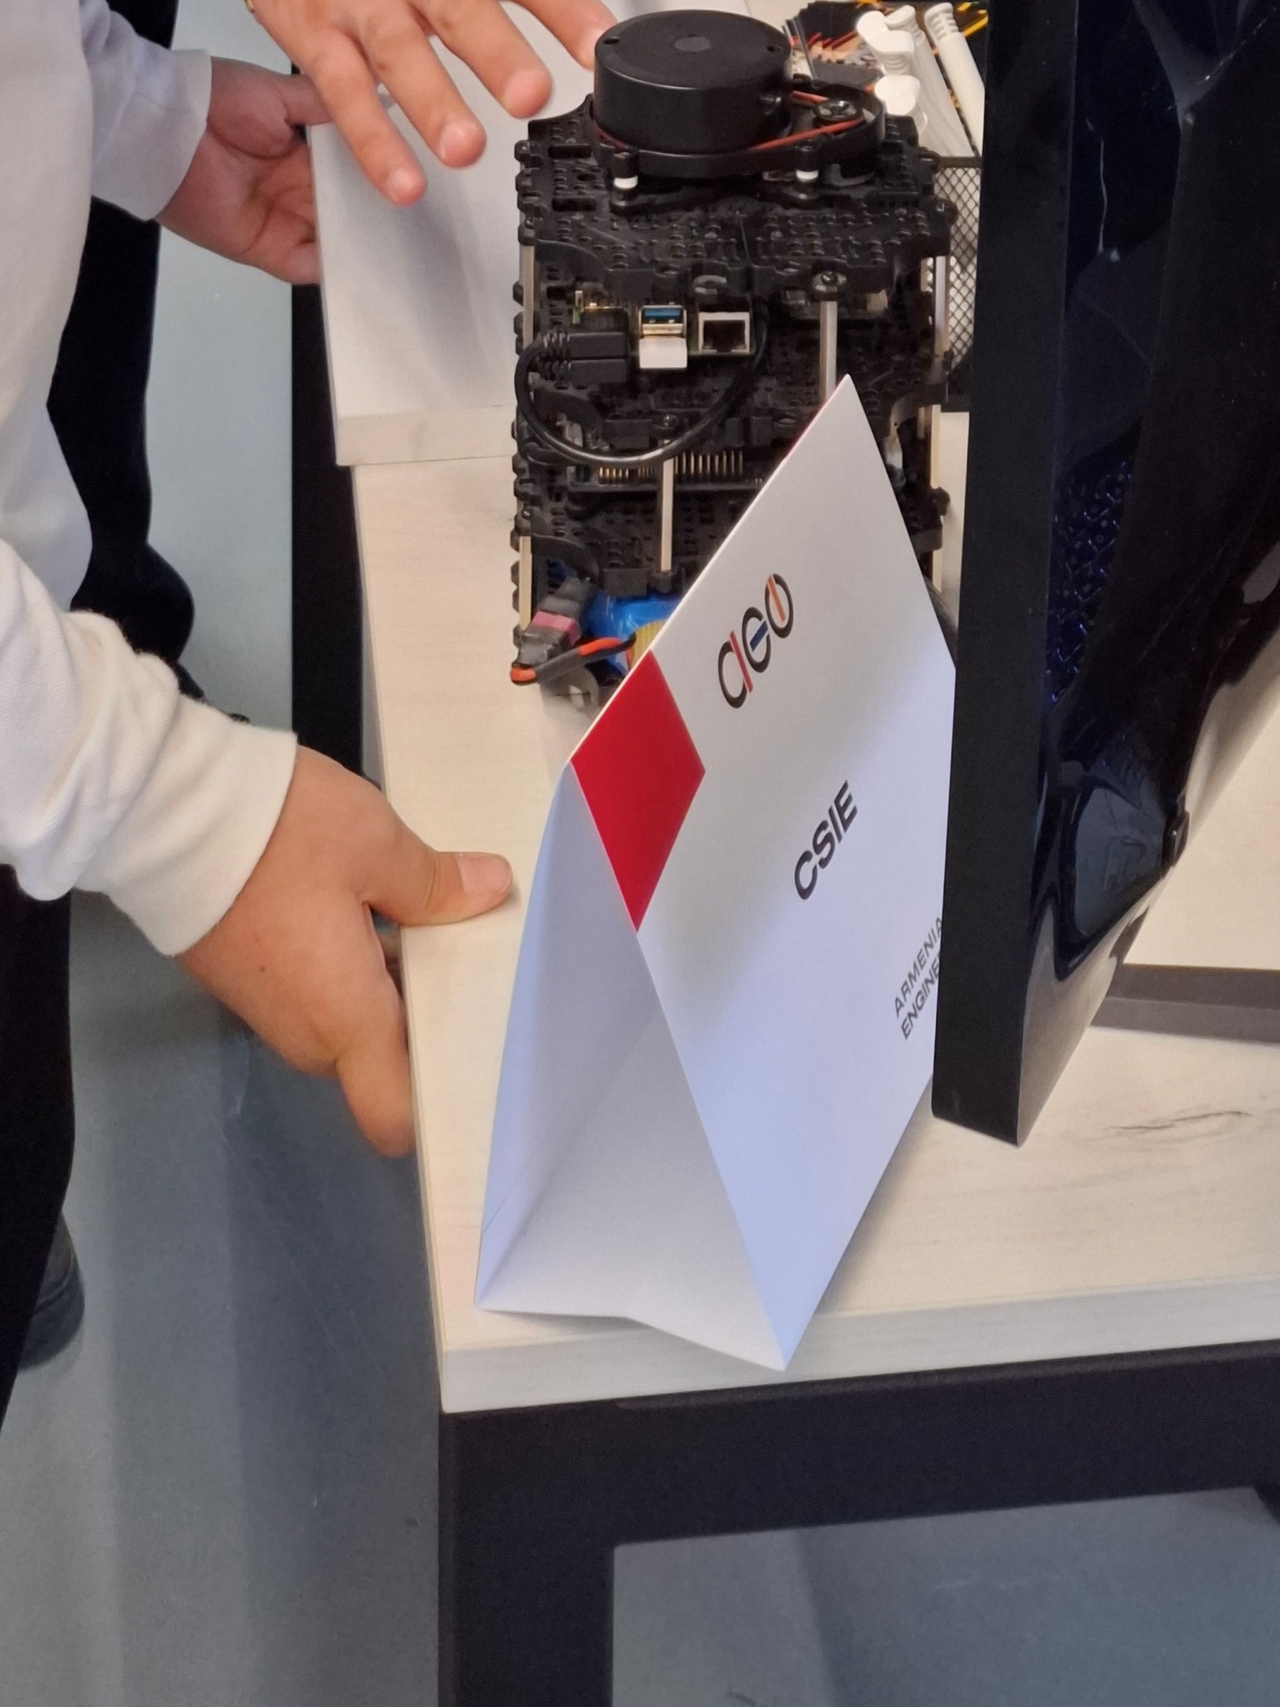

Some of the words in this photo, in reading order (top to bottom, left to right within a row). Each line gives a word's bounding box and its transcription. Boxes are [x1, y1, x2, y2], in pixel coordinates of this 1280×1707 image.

[794, 780, 858, 901] CSIE
[894, 916, 942, 1019] ARMENIA
[901, 953, 940, 1041] ENGINE
